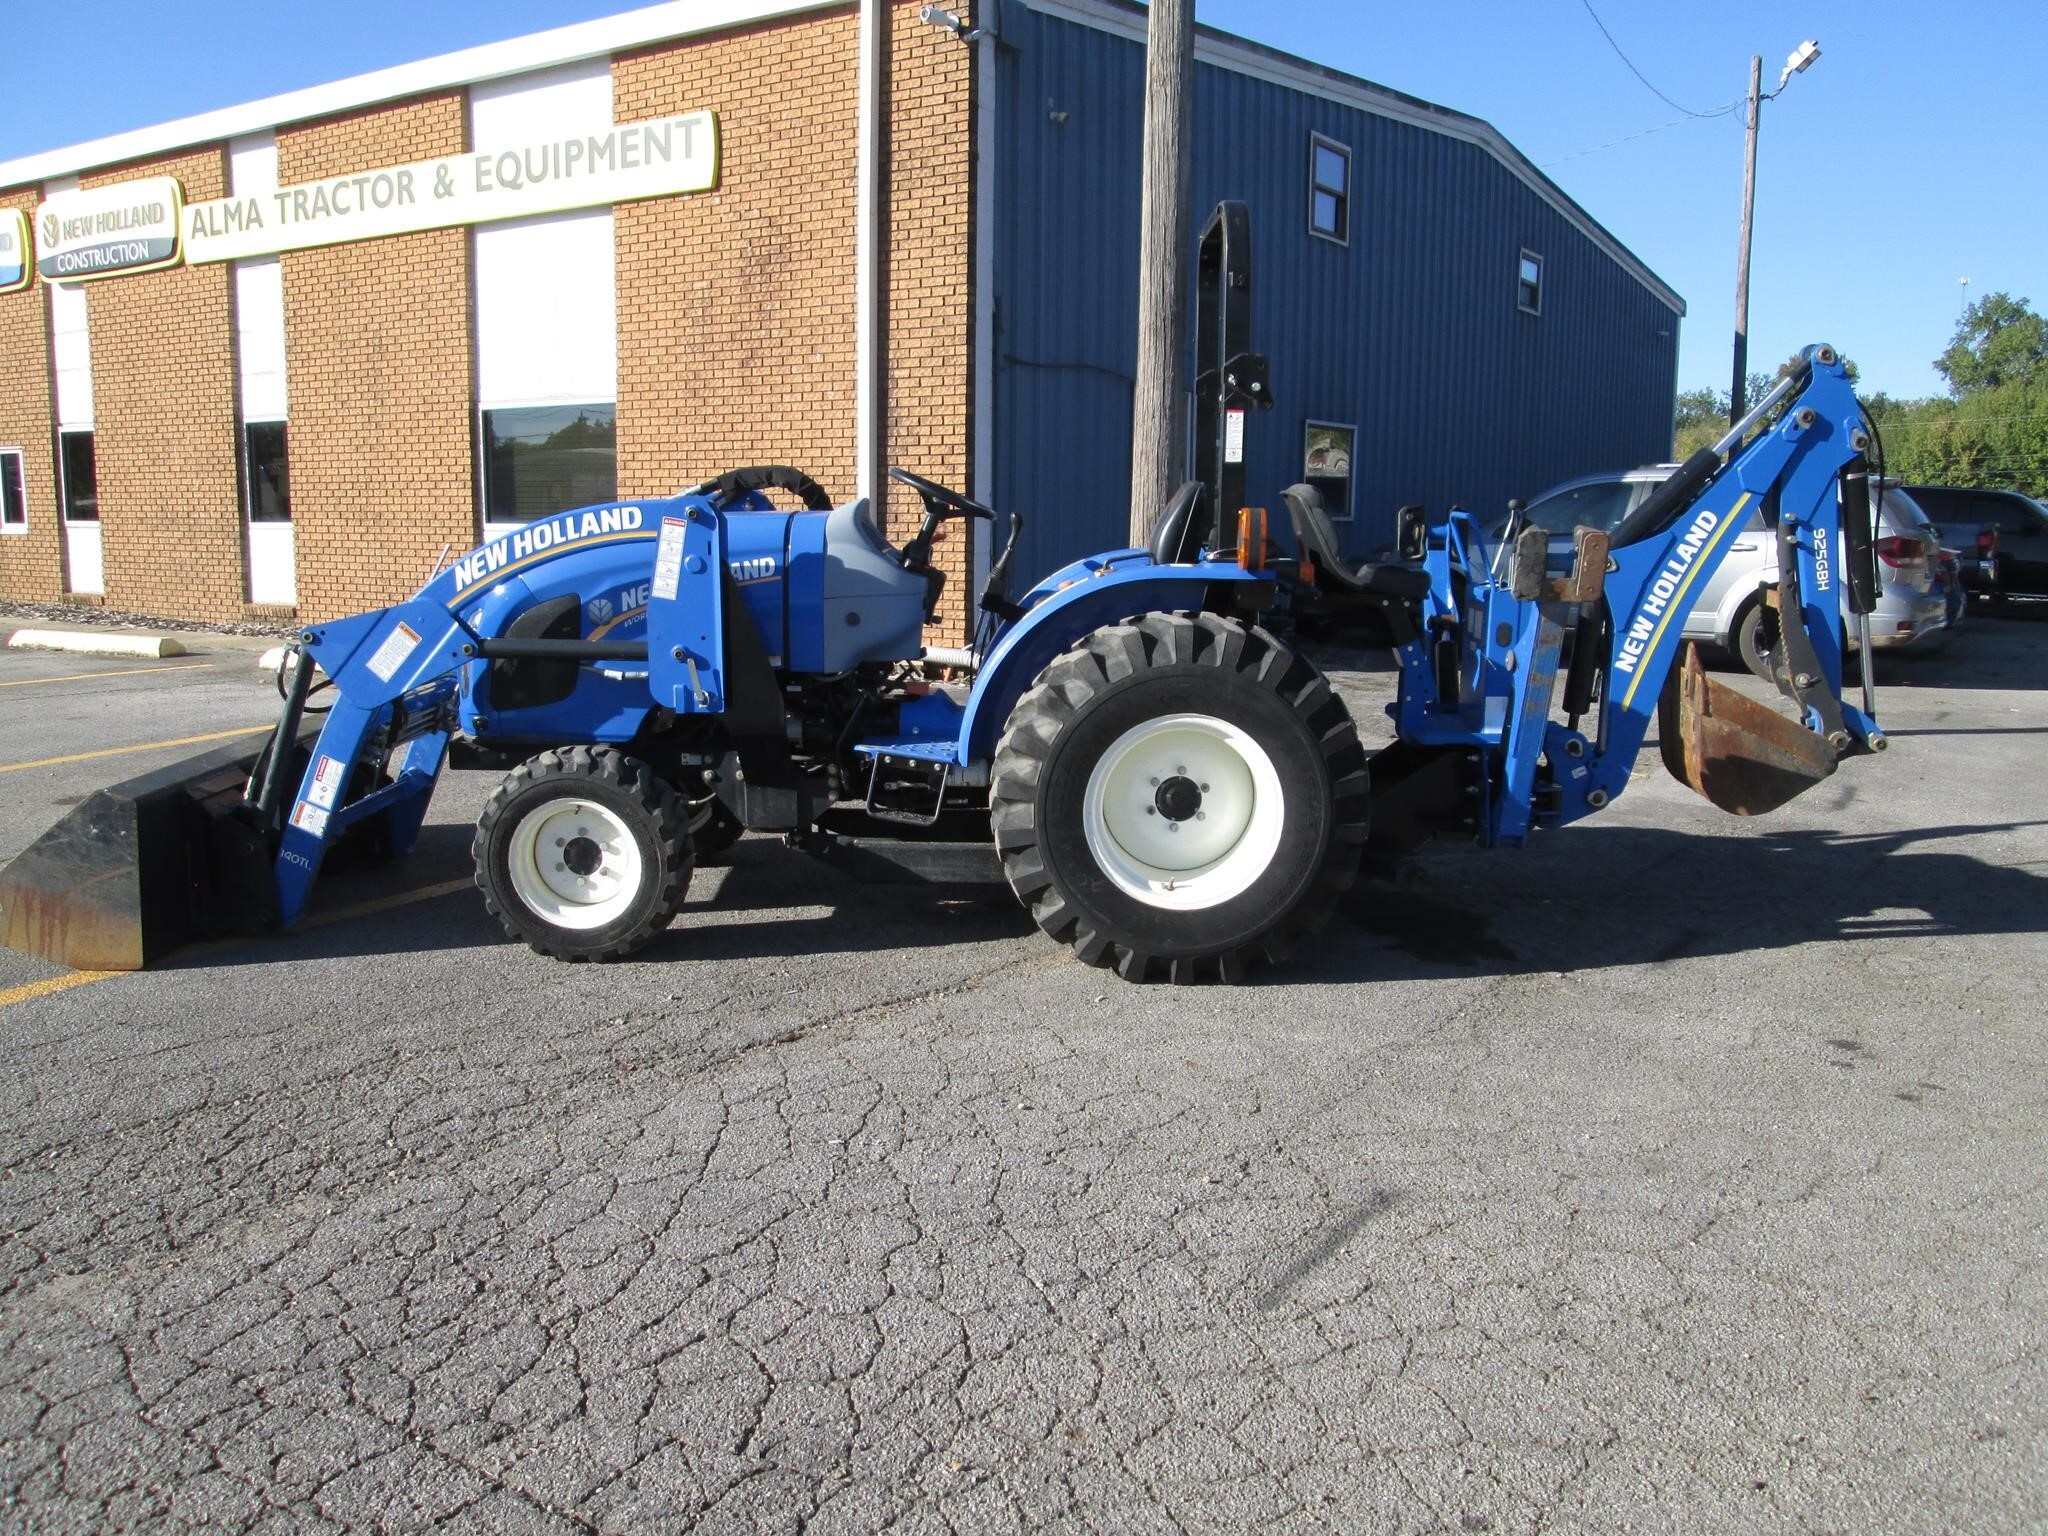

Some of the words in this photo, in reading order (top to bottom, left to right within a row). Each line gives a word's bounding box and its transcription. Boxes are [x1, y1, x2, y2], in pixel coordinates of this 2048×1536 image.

[191, 198, 264, 240] ALMA
[274, 170, 416, 225] TRACTOR
[433, 163, 455, 200] &
[475, 117, 702, 193] EQUIPMENT
[63, 214, 94, 240] NEW
[95, 202, 166, 233] HOLLAND
[57, 241, 149, 272] CONSTRUCTION
[454, 538, 508, 593] NEW
[513, 506, 643, 559] HOLLAND
[1813, 528, 1830, 591] 925GBH
[620, 583, 649, 612] NE
[729, 556, 776, 581] AND
[1614, 614, 1655, 673] NEW
[1643, 510, 1719, 616] HOLLAND
